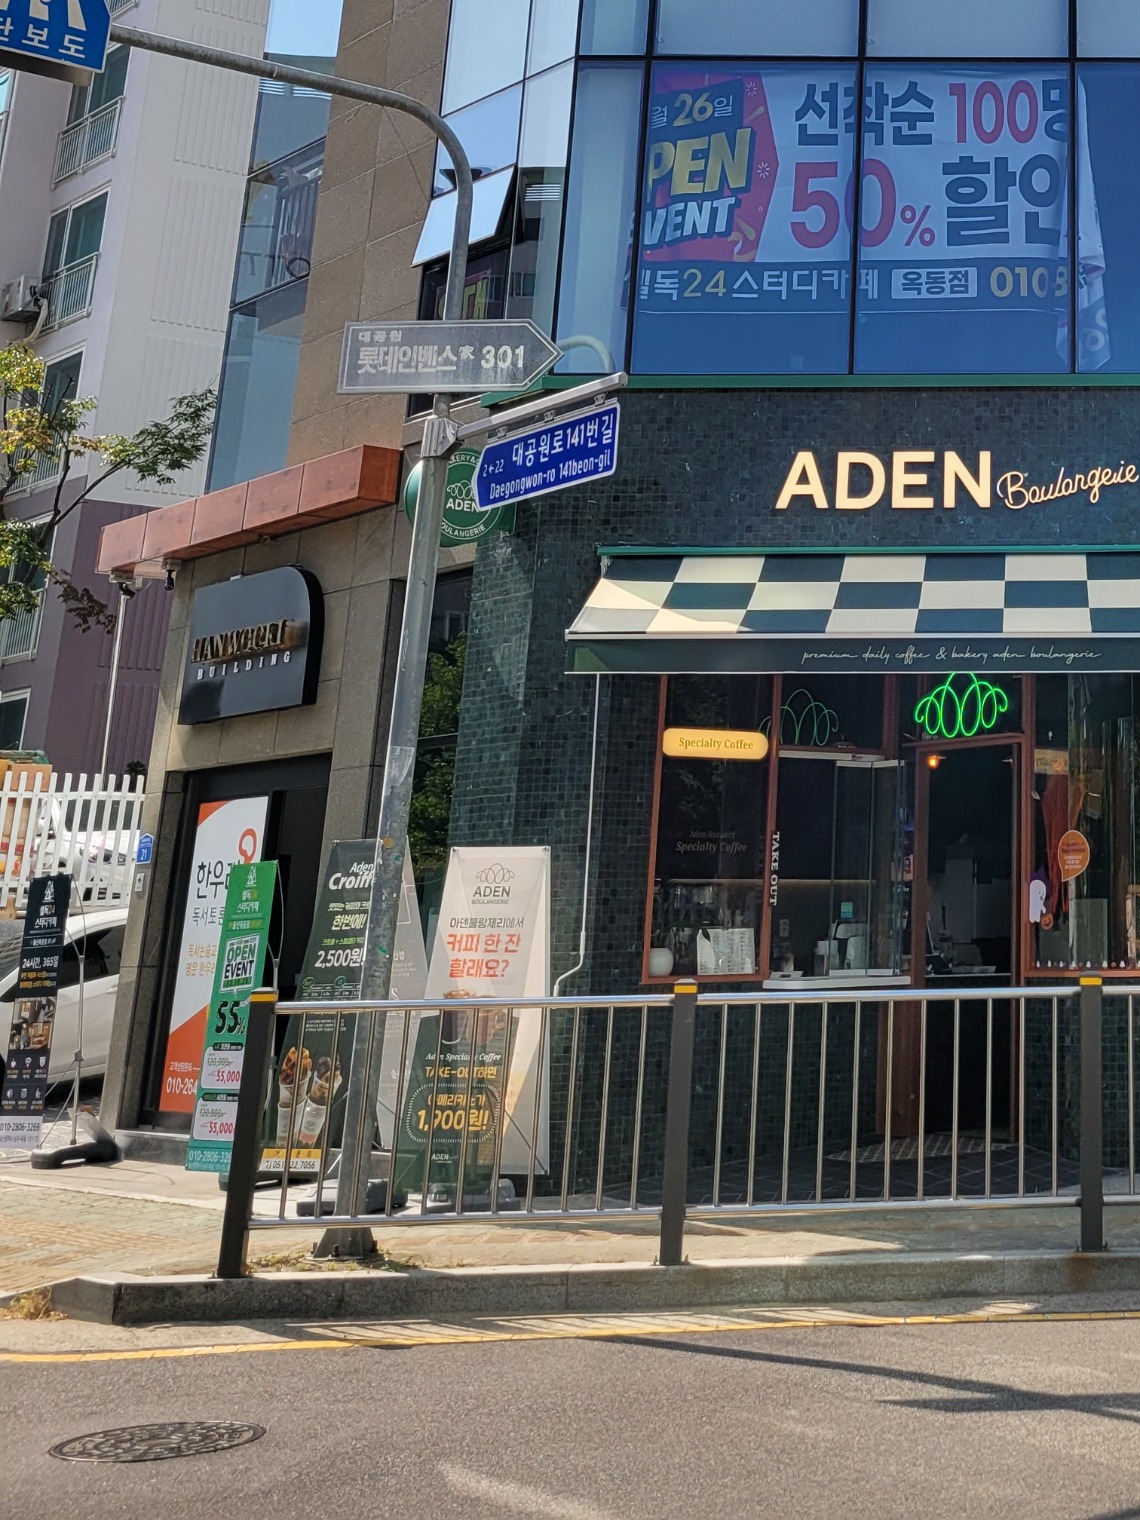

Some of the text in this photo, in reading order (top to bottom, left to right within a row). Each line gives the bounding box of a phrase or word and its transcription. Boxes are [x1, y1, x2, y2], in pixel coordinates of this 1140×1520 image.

[673, 91, 733, 127] 26일
[795, 81, 935, 147] 선착순
[647, 127, 752, 202] PEN
[789, 157, 936, 251] 50%
[643, 196, 736, 246] VENT
[900, 270, 969, 296] 옥동점
[358, 329, 403, 343] 대공원
[480, 344, 526, 370] 301
[511, 412, 614, 468] 대공원로141번길
[489, 449, 612, 500] Daegongwon-ro 141beon-gil
[774, 450, 1140, 510] ADEN Boulangerie
[446, 499, 481, 513] ADEN
[441, 523, 486, 538] OULANGERIE
[800, 644, 1102, 665] premium daily coffee & bakery aden boulangerie
[196, 651, 291, 681] BUILDING
[678, 736, 754, 751] Specialty Coffee
[675, 841, 748, 854] Specialty Coffee
[349, 861, 374, 874] Aden
[769, 831, 780, 906] TAKE OUT
[328, 870, 375, 891] Croiff
[472, 885, 512, 898] ADEN
[331, 913, 367, 930] 한번에!
[226, 943, 256, 964] OPEN
[446, 932, 522, 954] 커피 한 잔
[42, 955, 59, 968] 365일
[224, 959, 255, 980] EVENT
[448, 958, 510, 979] 할래요?
[214, 1000, 246, 1037] 55%
[479, 1052, 501, 1062] Coffee
[431, 1153, 449, 1161] ADEN
